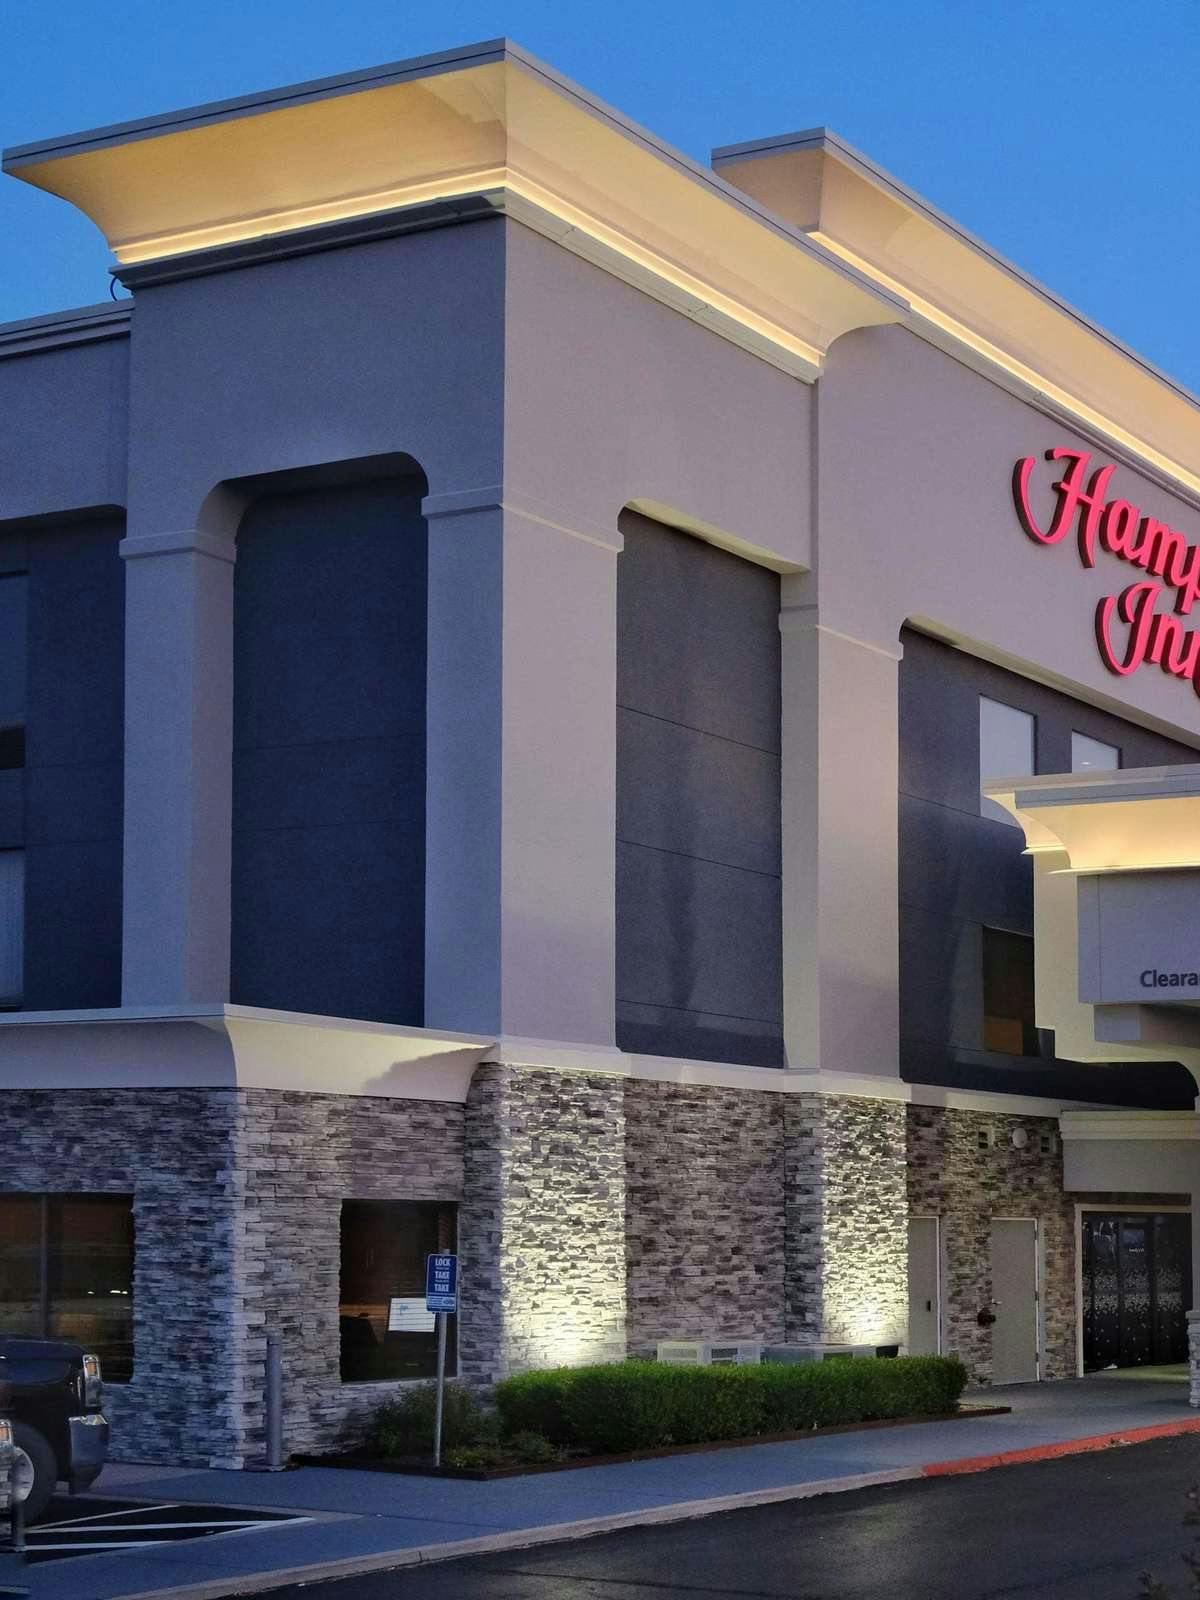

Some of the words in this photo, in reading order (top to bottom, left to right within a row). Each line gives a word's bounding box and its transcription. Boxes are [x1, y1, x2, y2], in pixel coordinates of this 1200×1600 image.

[435, 1258, 451, 1266] LOCK
[434, 1271, 450, 1279] TAKE
[434, 1283, 450, 1292] TAKE
